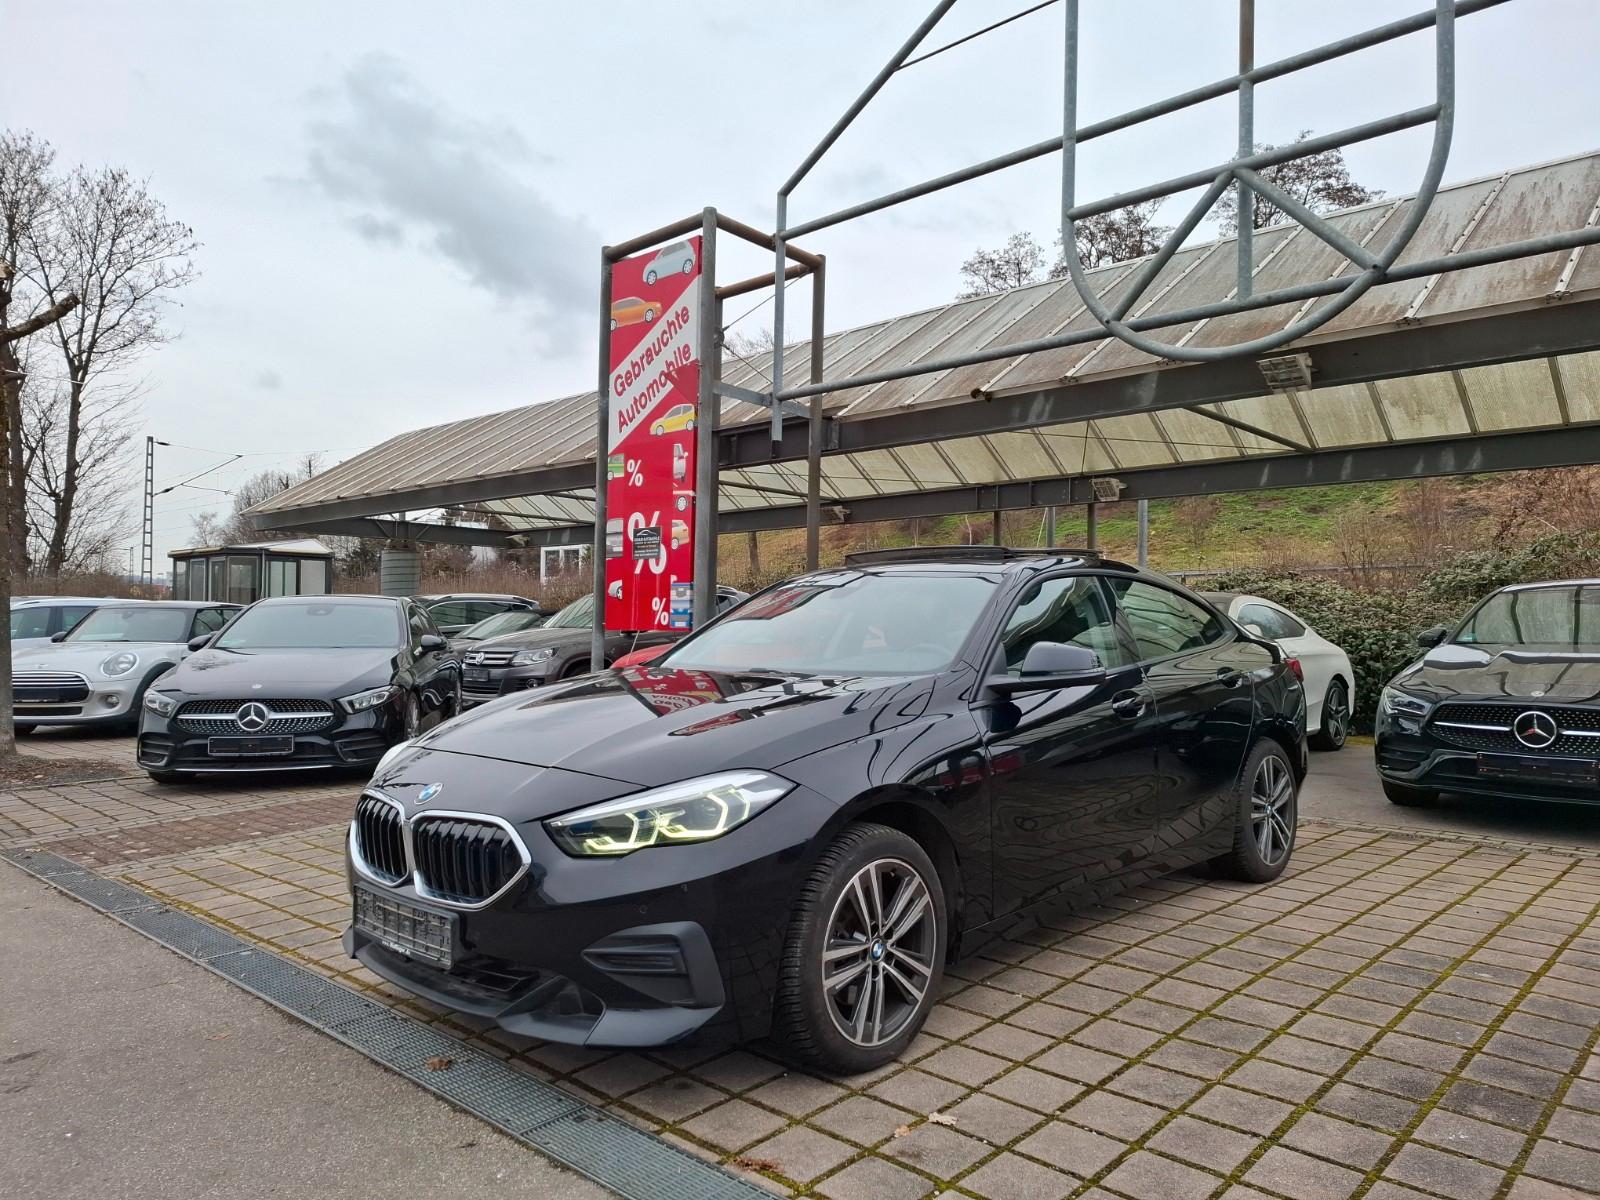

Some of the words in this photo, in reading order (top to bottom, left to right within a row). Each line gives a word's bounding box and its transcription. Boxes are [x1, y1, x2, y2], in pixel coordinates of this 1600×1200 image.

[613, 306, 690, 397] Gebrauchte
[626, 458, 643, 487] %
[651, 596, 669, 626] %
